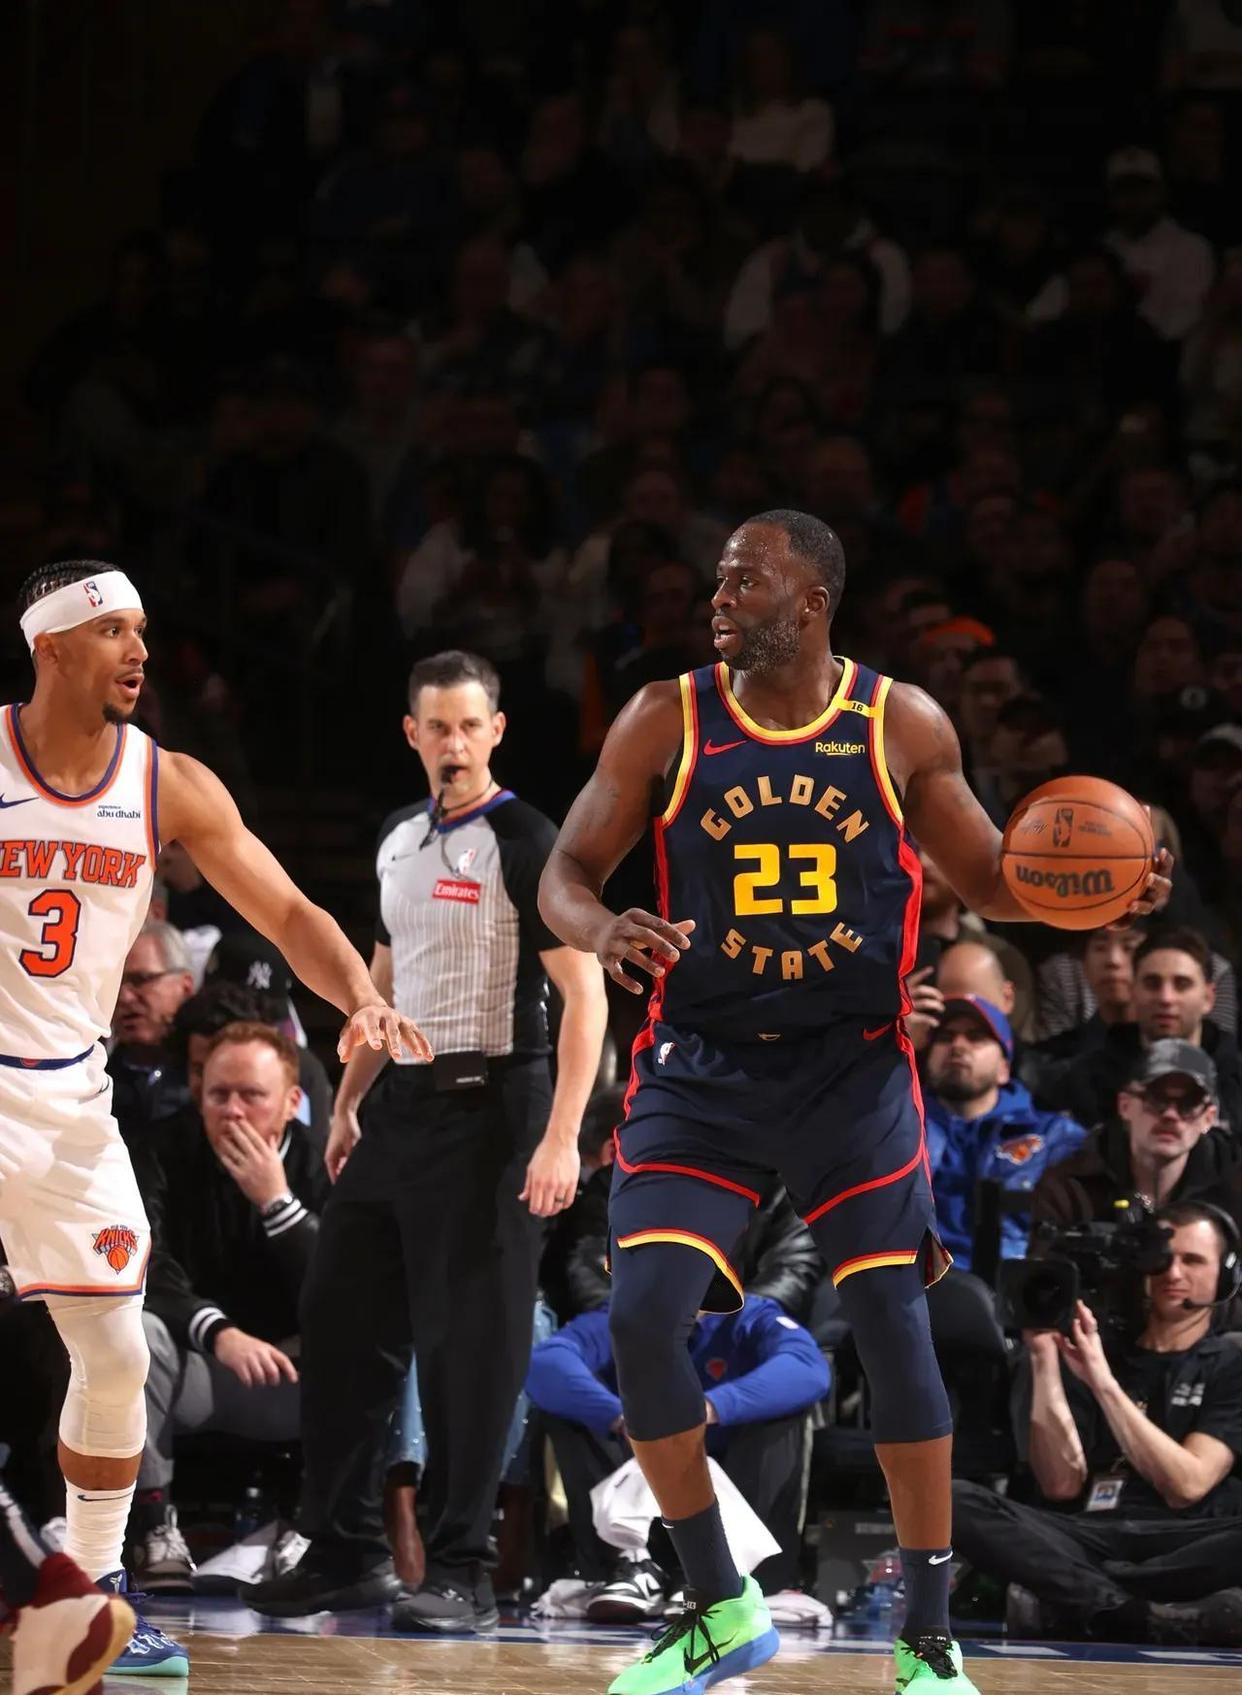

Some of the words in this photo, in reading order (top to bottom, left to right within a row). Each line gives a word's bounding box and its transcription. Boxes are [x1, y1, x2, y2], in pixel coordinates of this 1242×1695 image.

[851, 702, 864, 712] 16
[815, 741, 866, 755] Rakuten
[97, 810, 115, 818] abu
[115, 810, 141, 819] dhabi
[700, 774, 869, 842] GOLDEN
[0, 839, 59, 878] EW
[61, 841, 147, 889] YORK
[733, 843, 838, 916] 23
[1015, 863, 1115, 898] Wilson
[434, 882, 480, 900] Emirates
[19, 888, 82, 978] 3
[720, 921, 864, 980] STATE
